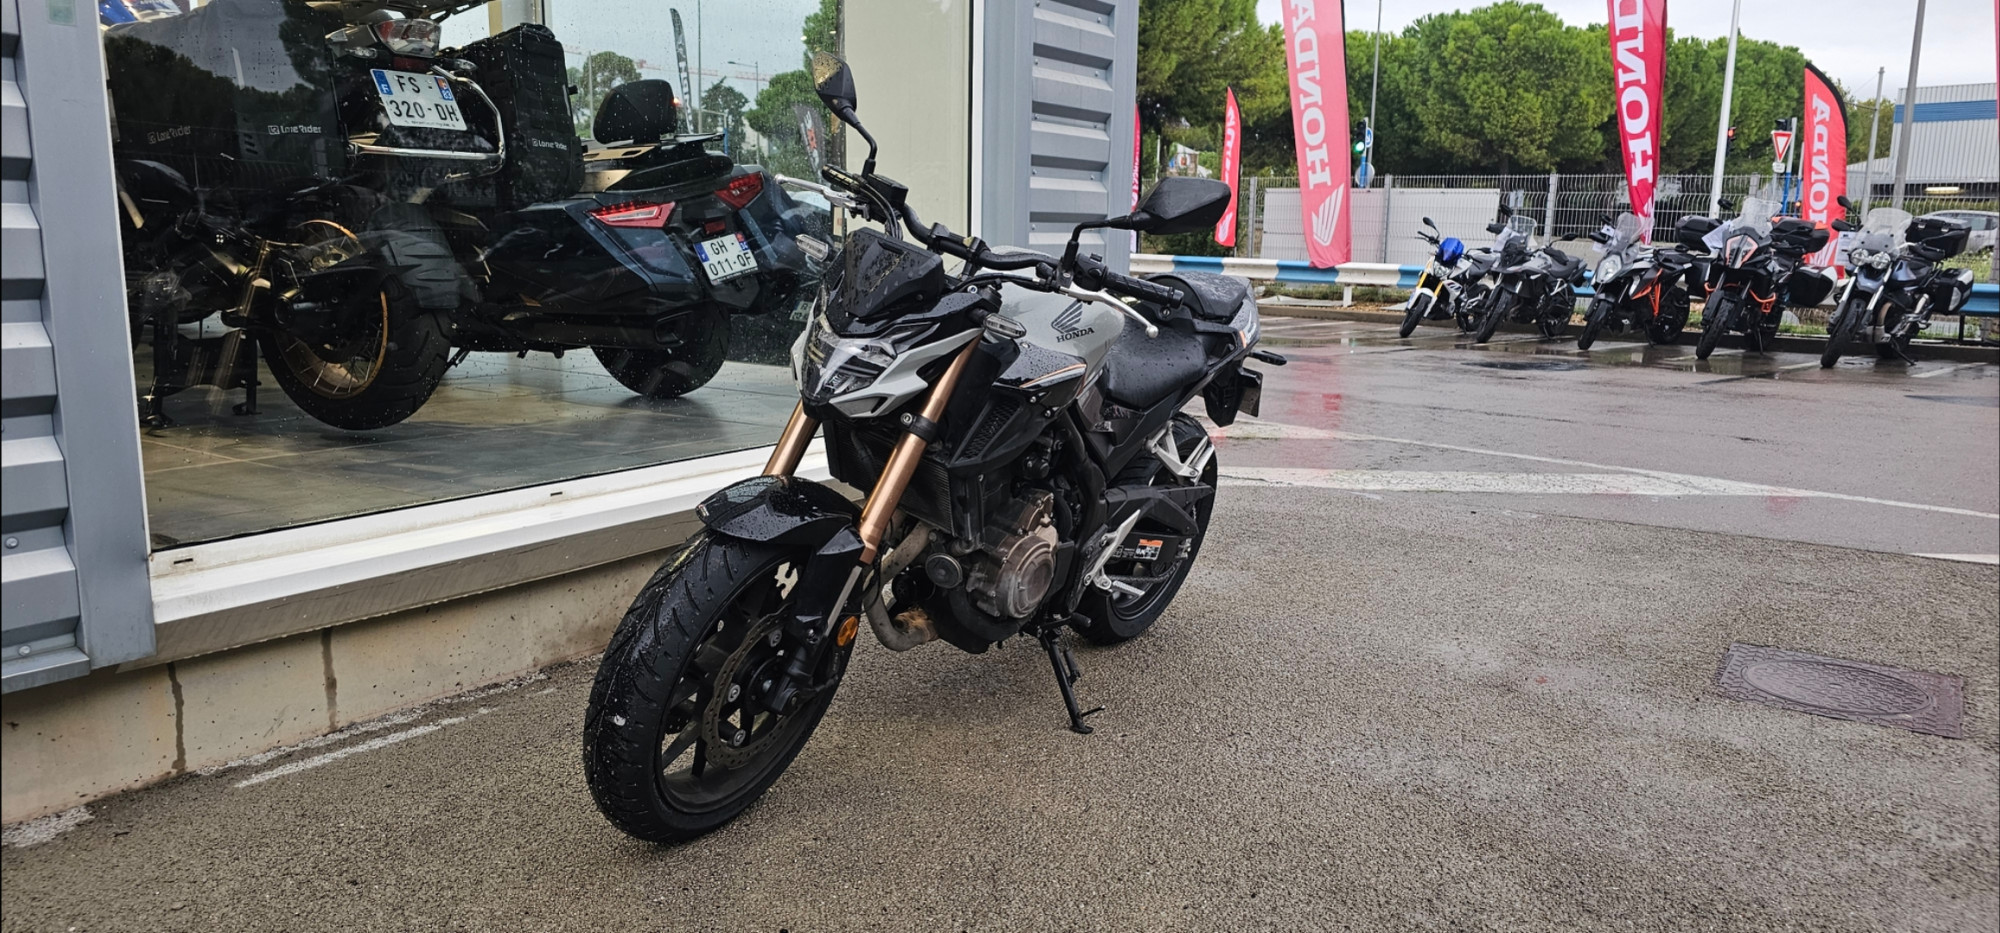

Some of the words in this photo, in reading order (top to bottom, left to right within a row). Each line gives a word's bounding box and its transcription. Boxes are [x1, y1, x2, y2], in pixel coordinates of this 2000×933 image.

[394, 74, 421, 94] FS
[389, 99, 460, 122] 320-DH
[710, 239, 729, 256] GH
[1056, 327, 1096, 343] HONDA
